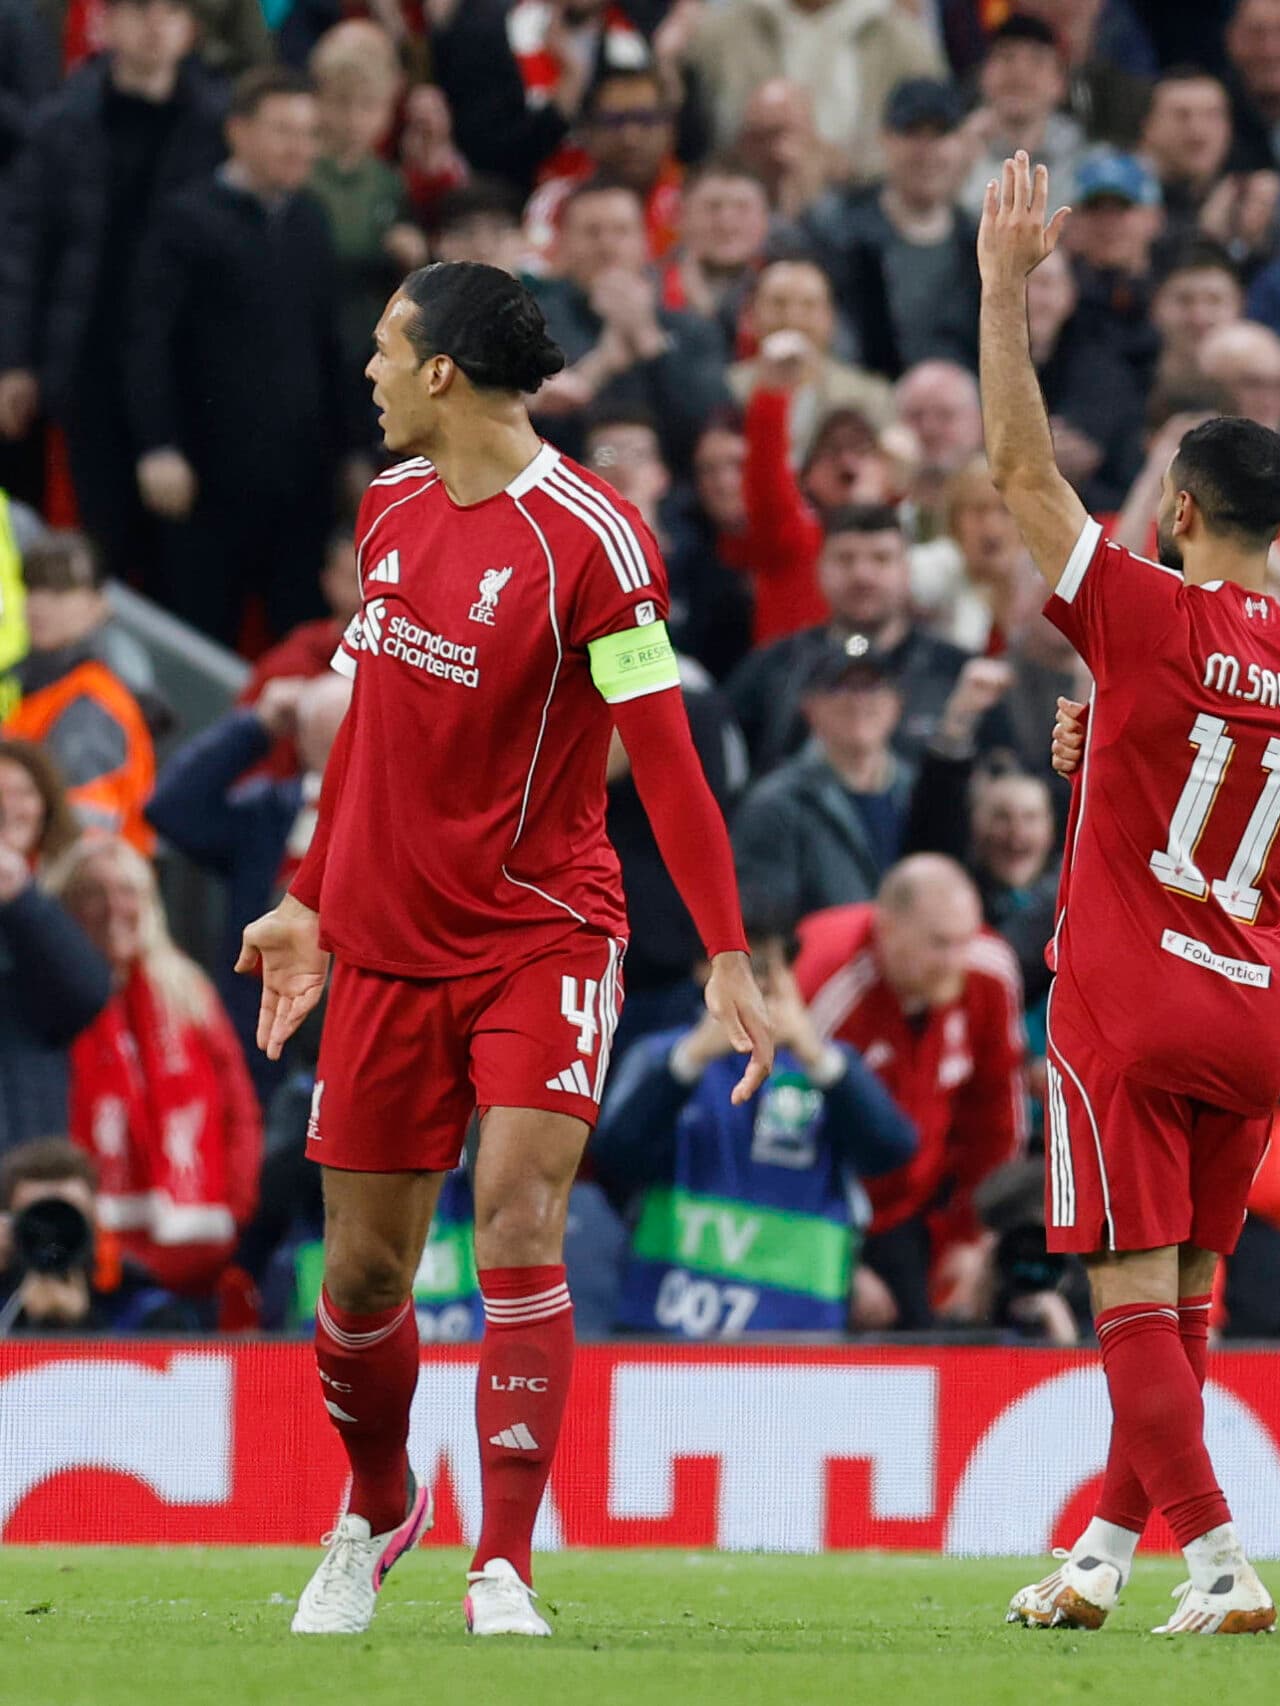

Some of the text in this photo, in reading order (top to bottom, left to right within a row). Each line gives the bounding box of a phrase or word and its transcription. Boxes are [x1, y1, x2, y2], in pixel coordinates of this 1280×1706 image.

[383, 637, 479, 688] chartered
[388, 616, 477, 666] standard
[561, 975, 598, 1055] 4
[676, 1202, 762, 1265] TV
[655, 1269, 760, 1338] 007
[491, 1375, 549, 1392] LFC
